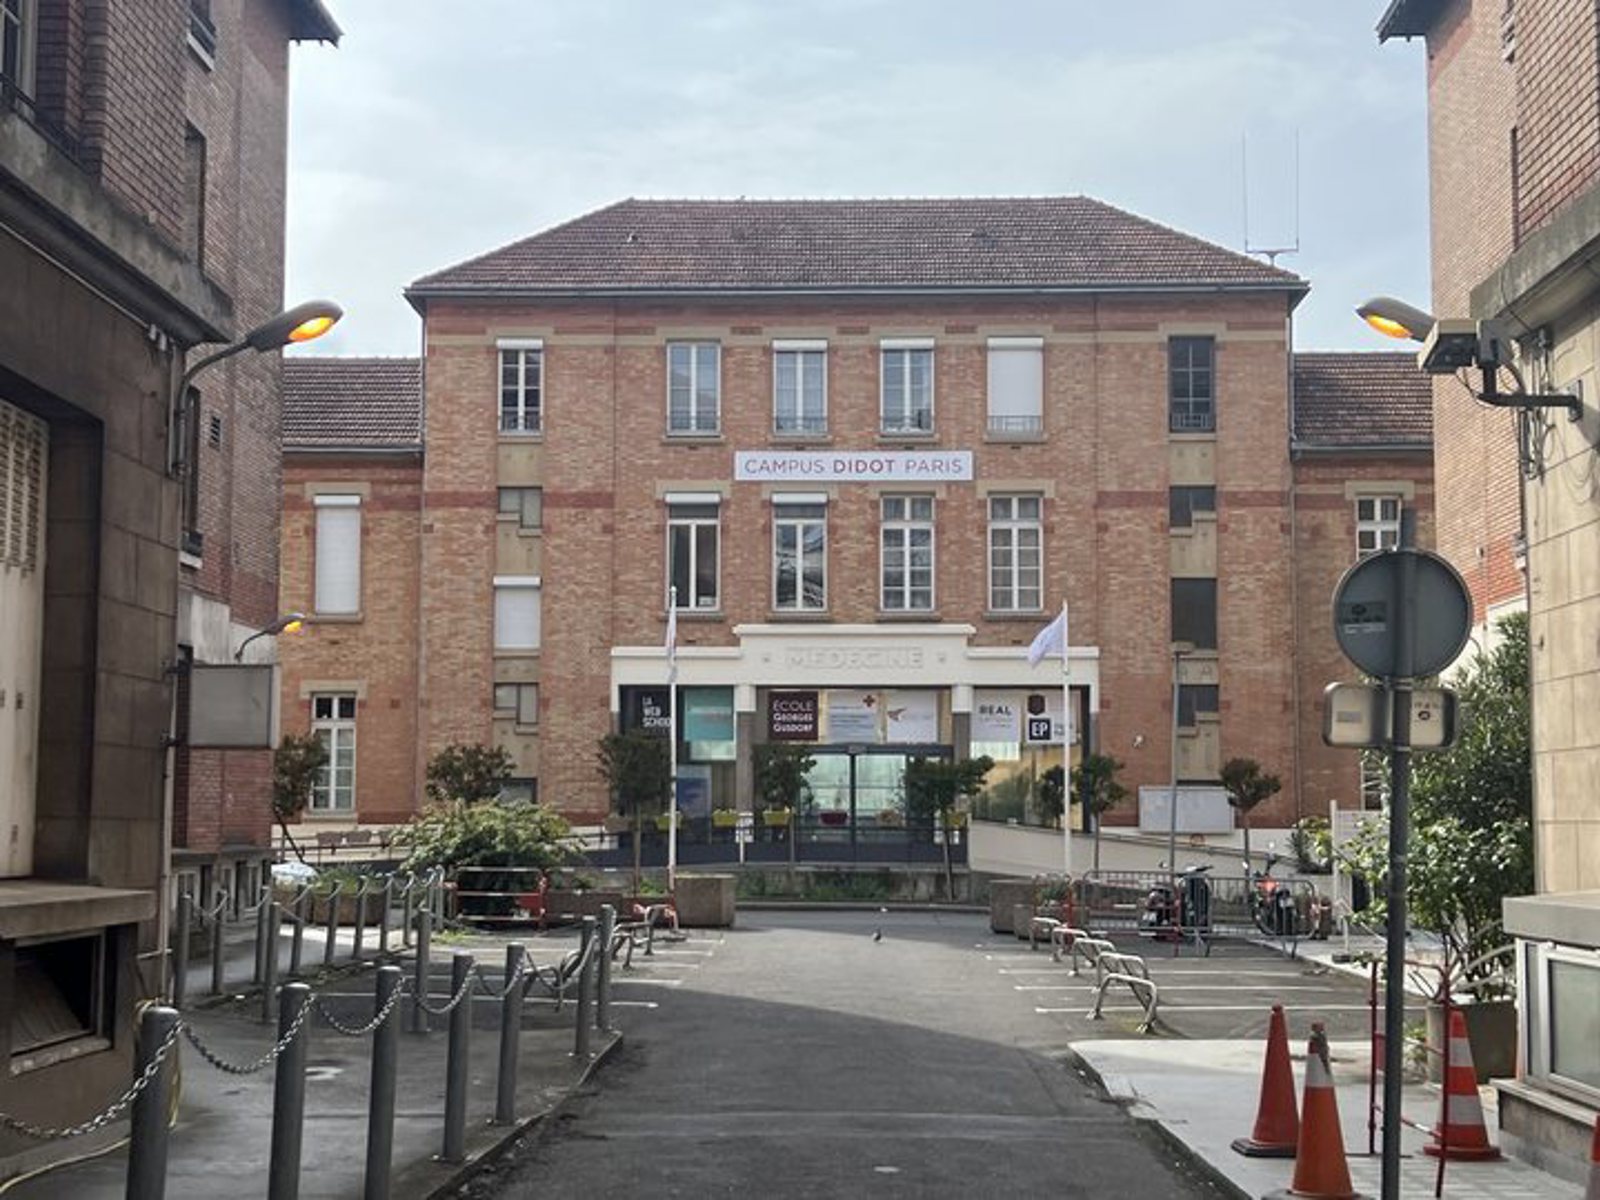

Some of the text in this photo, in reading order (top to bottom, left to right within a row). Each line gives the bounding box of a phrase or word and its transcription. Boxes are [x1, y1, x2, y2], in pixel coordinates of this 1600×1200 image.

[744, 459, 963, 474] CAMPUS DIDOT PARIS
[979, 704, 1012, 715] REAL
[1031, 721, 1049, 737] EP
